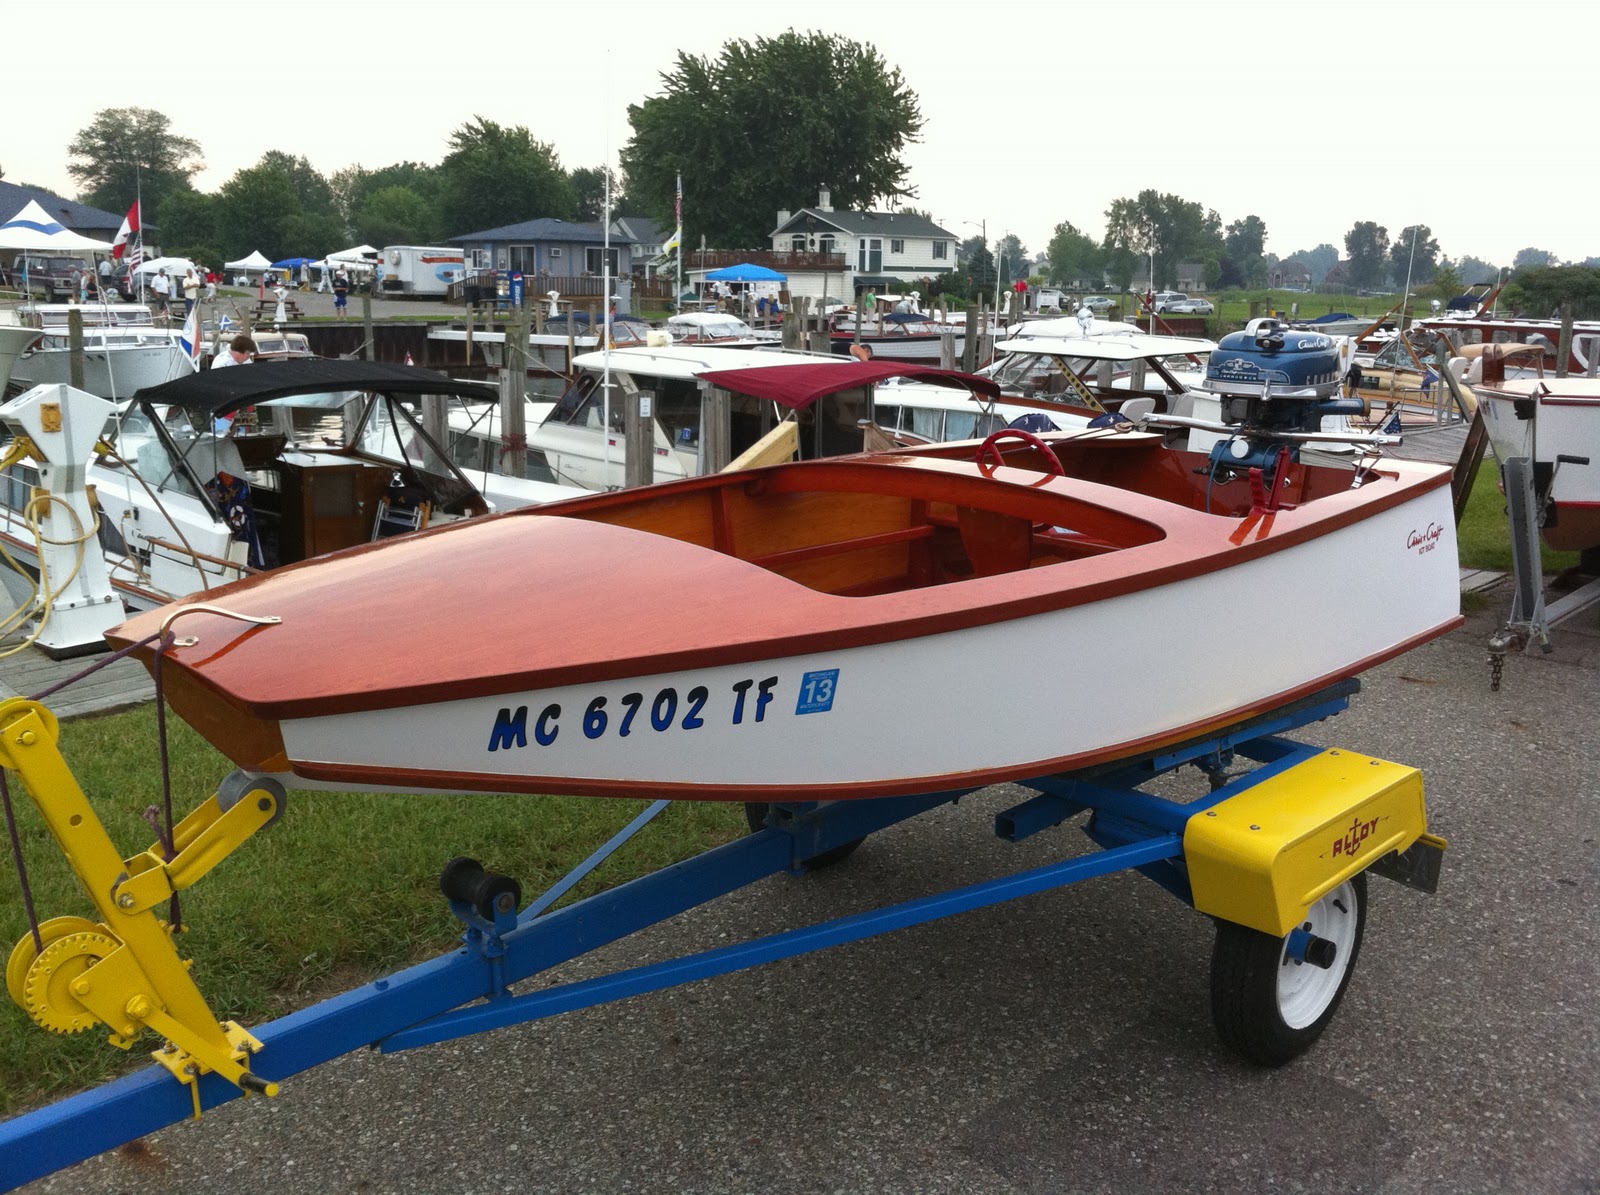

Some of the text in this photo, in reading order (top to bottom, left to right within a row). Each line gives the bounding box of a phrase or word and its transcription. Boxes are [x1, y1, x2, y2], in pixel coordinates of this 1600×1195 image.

[805, 679, 832, 704] 13
[487, 676, 778, 752] MC 6702 TF
[1332, 816, 1380, 858] ALLOY
